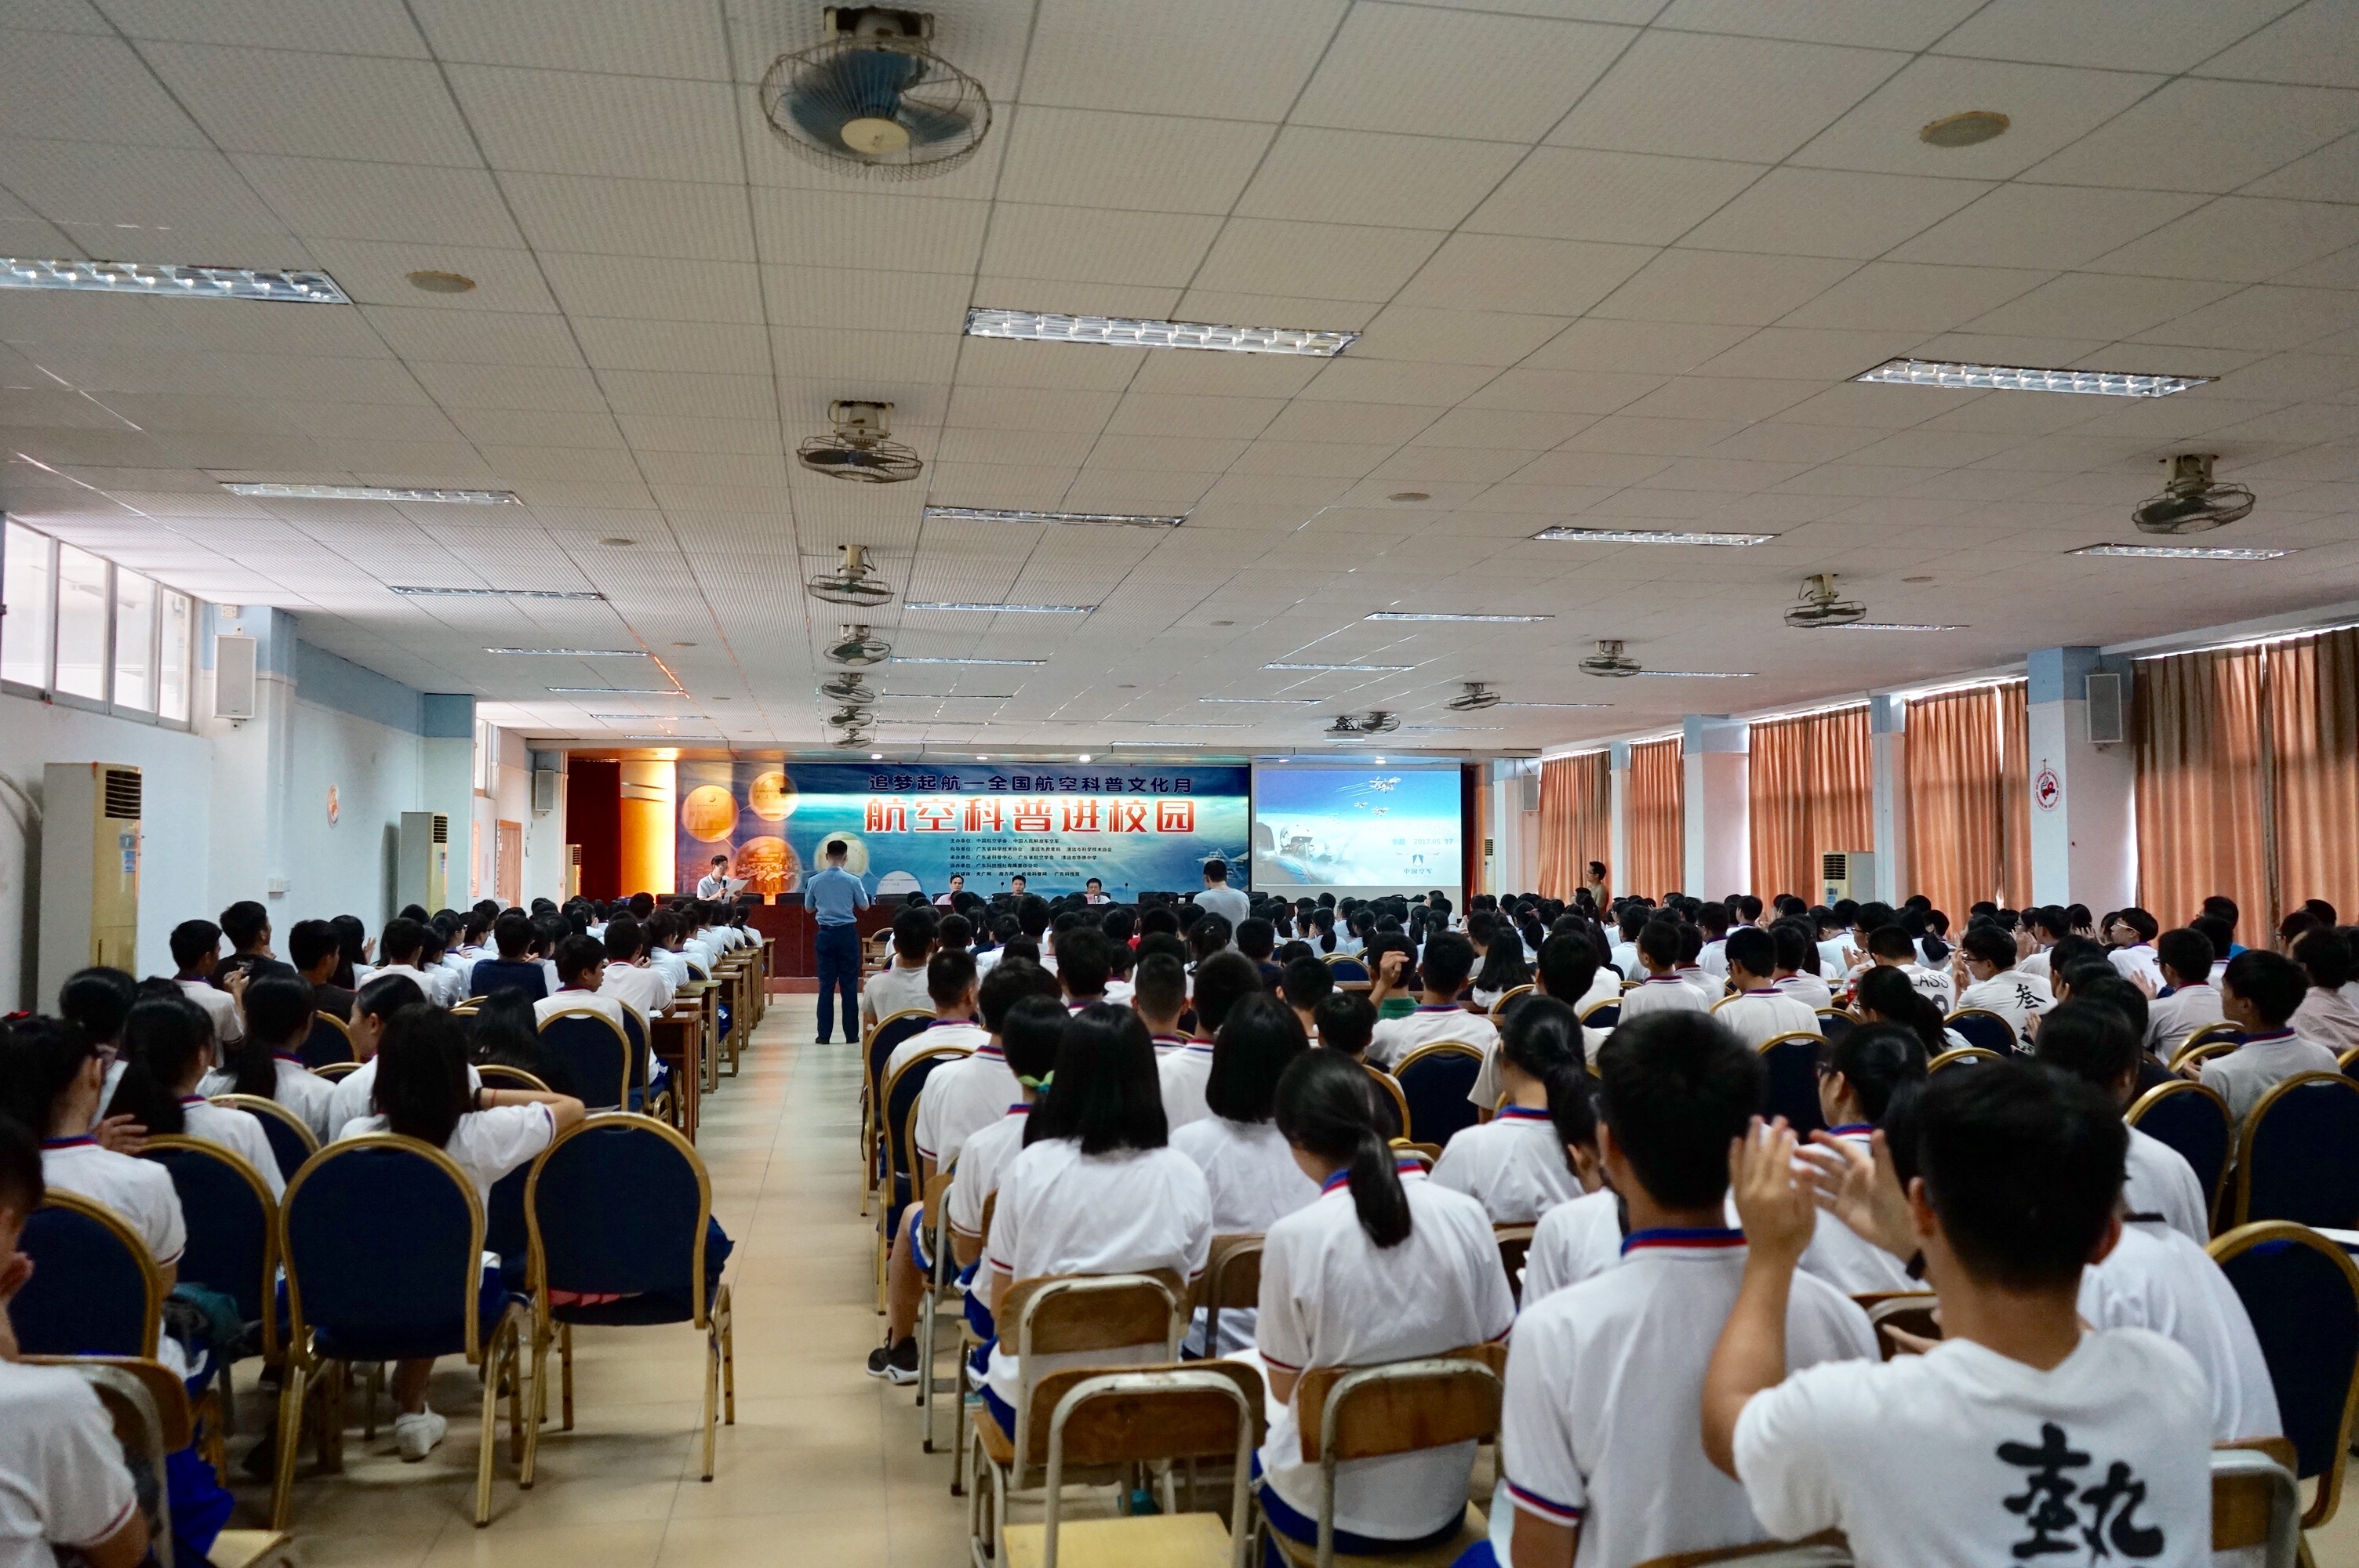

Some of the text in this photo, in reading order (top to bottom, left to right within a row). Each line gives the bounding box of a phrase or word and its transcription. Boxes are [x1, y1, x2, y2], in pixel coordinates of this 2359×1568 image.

[866, 797, 1195, 833] 航空科普进校园
